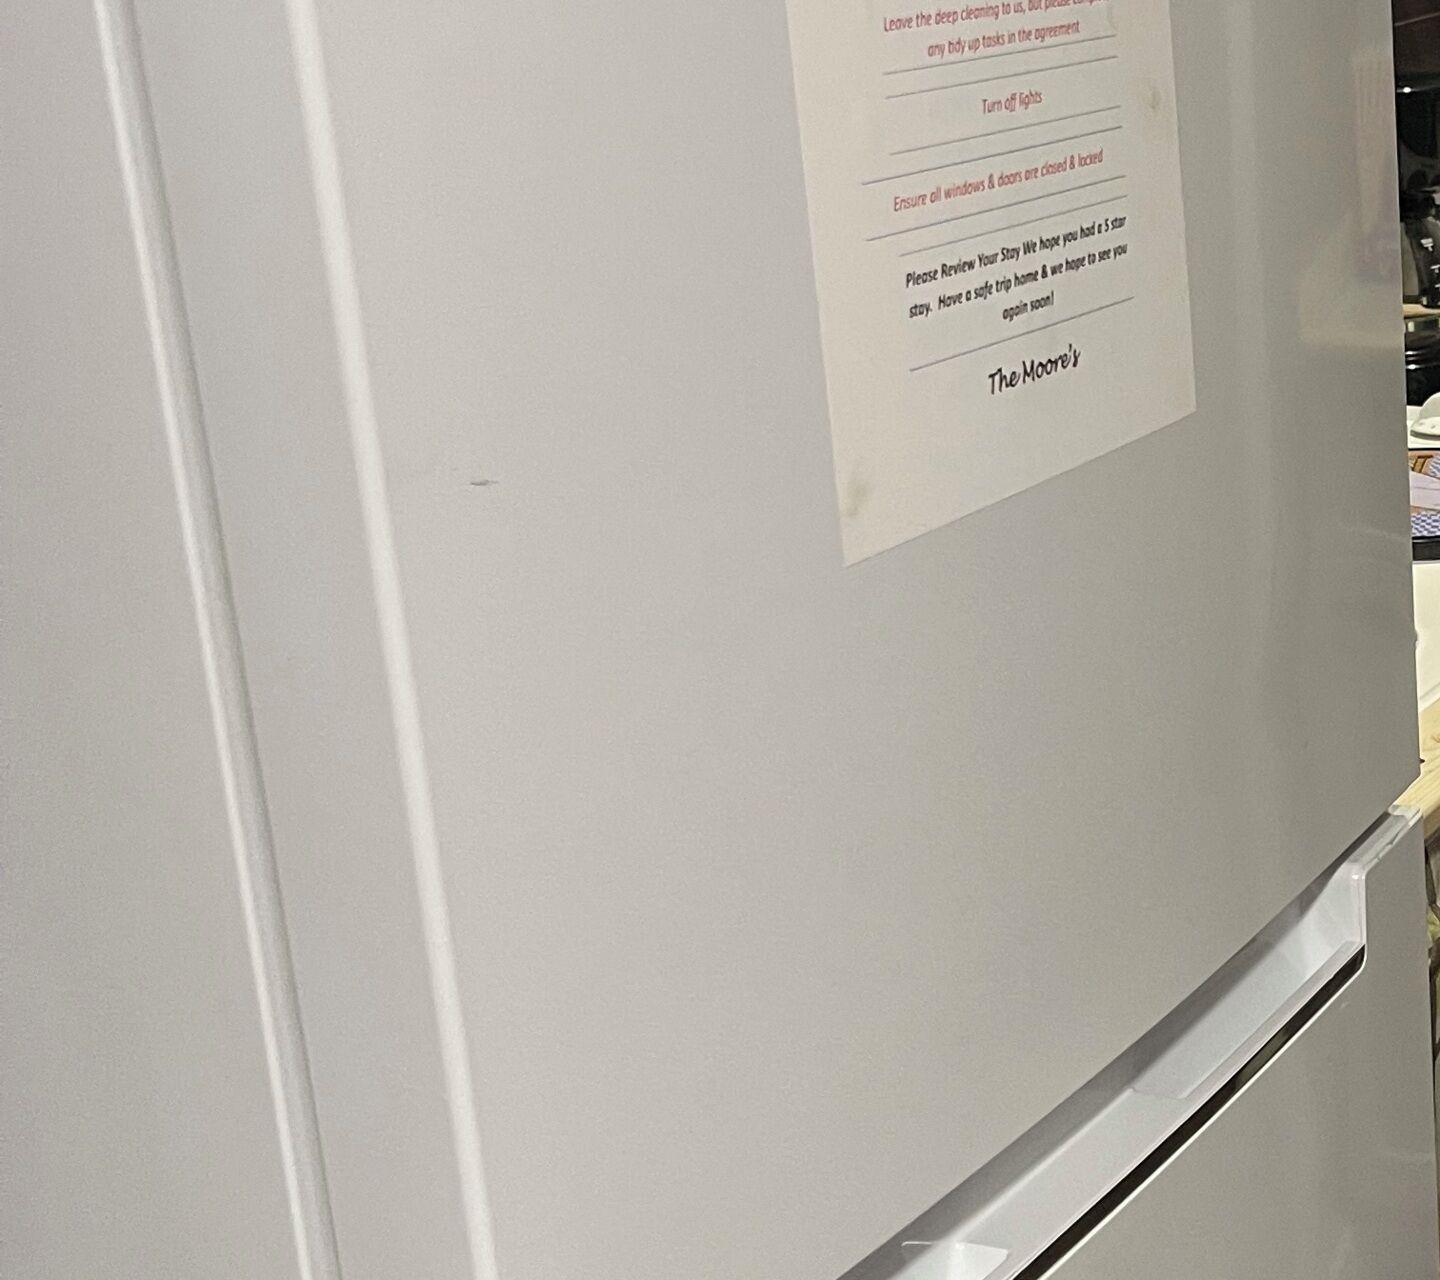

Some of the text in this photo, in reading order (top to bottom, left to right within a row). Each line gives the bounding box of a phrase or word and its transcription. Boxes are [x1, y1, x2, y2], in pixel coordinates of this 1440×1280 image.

[883, 16, 914, 32] Leave
[915, 12, 933, 29] the
[934, 9, 959, 27] deep
[961, 3, 1000, 22] cleaning
[1002, 2, 1011, 15] to
[1013, 0, 1026, 15] us,
[927, 20, 1080, 59] any tidy up tasks in the agreement
[982, 89, 1043, 114] Turn off lights
[894, 148, 1104, 212] Ensure all windows & doors are closed & locked
[906, 216, 1127, 288] Please Review Your Stay We hope you had a 5 star
[909, 243, 1128, 318] stay. Have a safe trip home & we hope to see you
[1002, 290, 1055, 322] again soon!
[988, 343, 1081, 395] The Moore's
